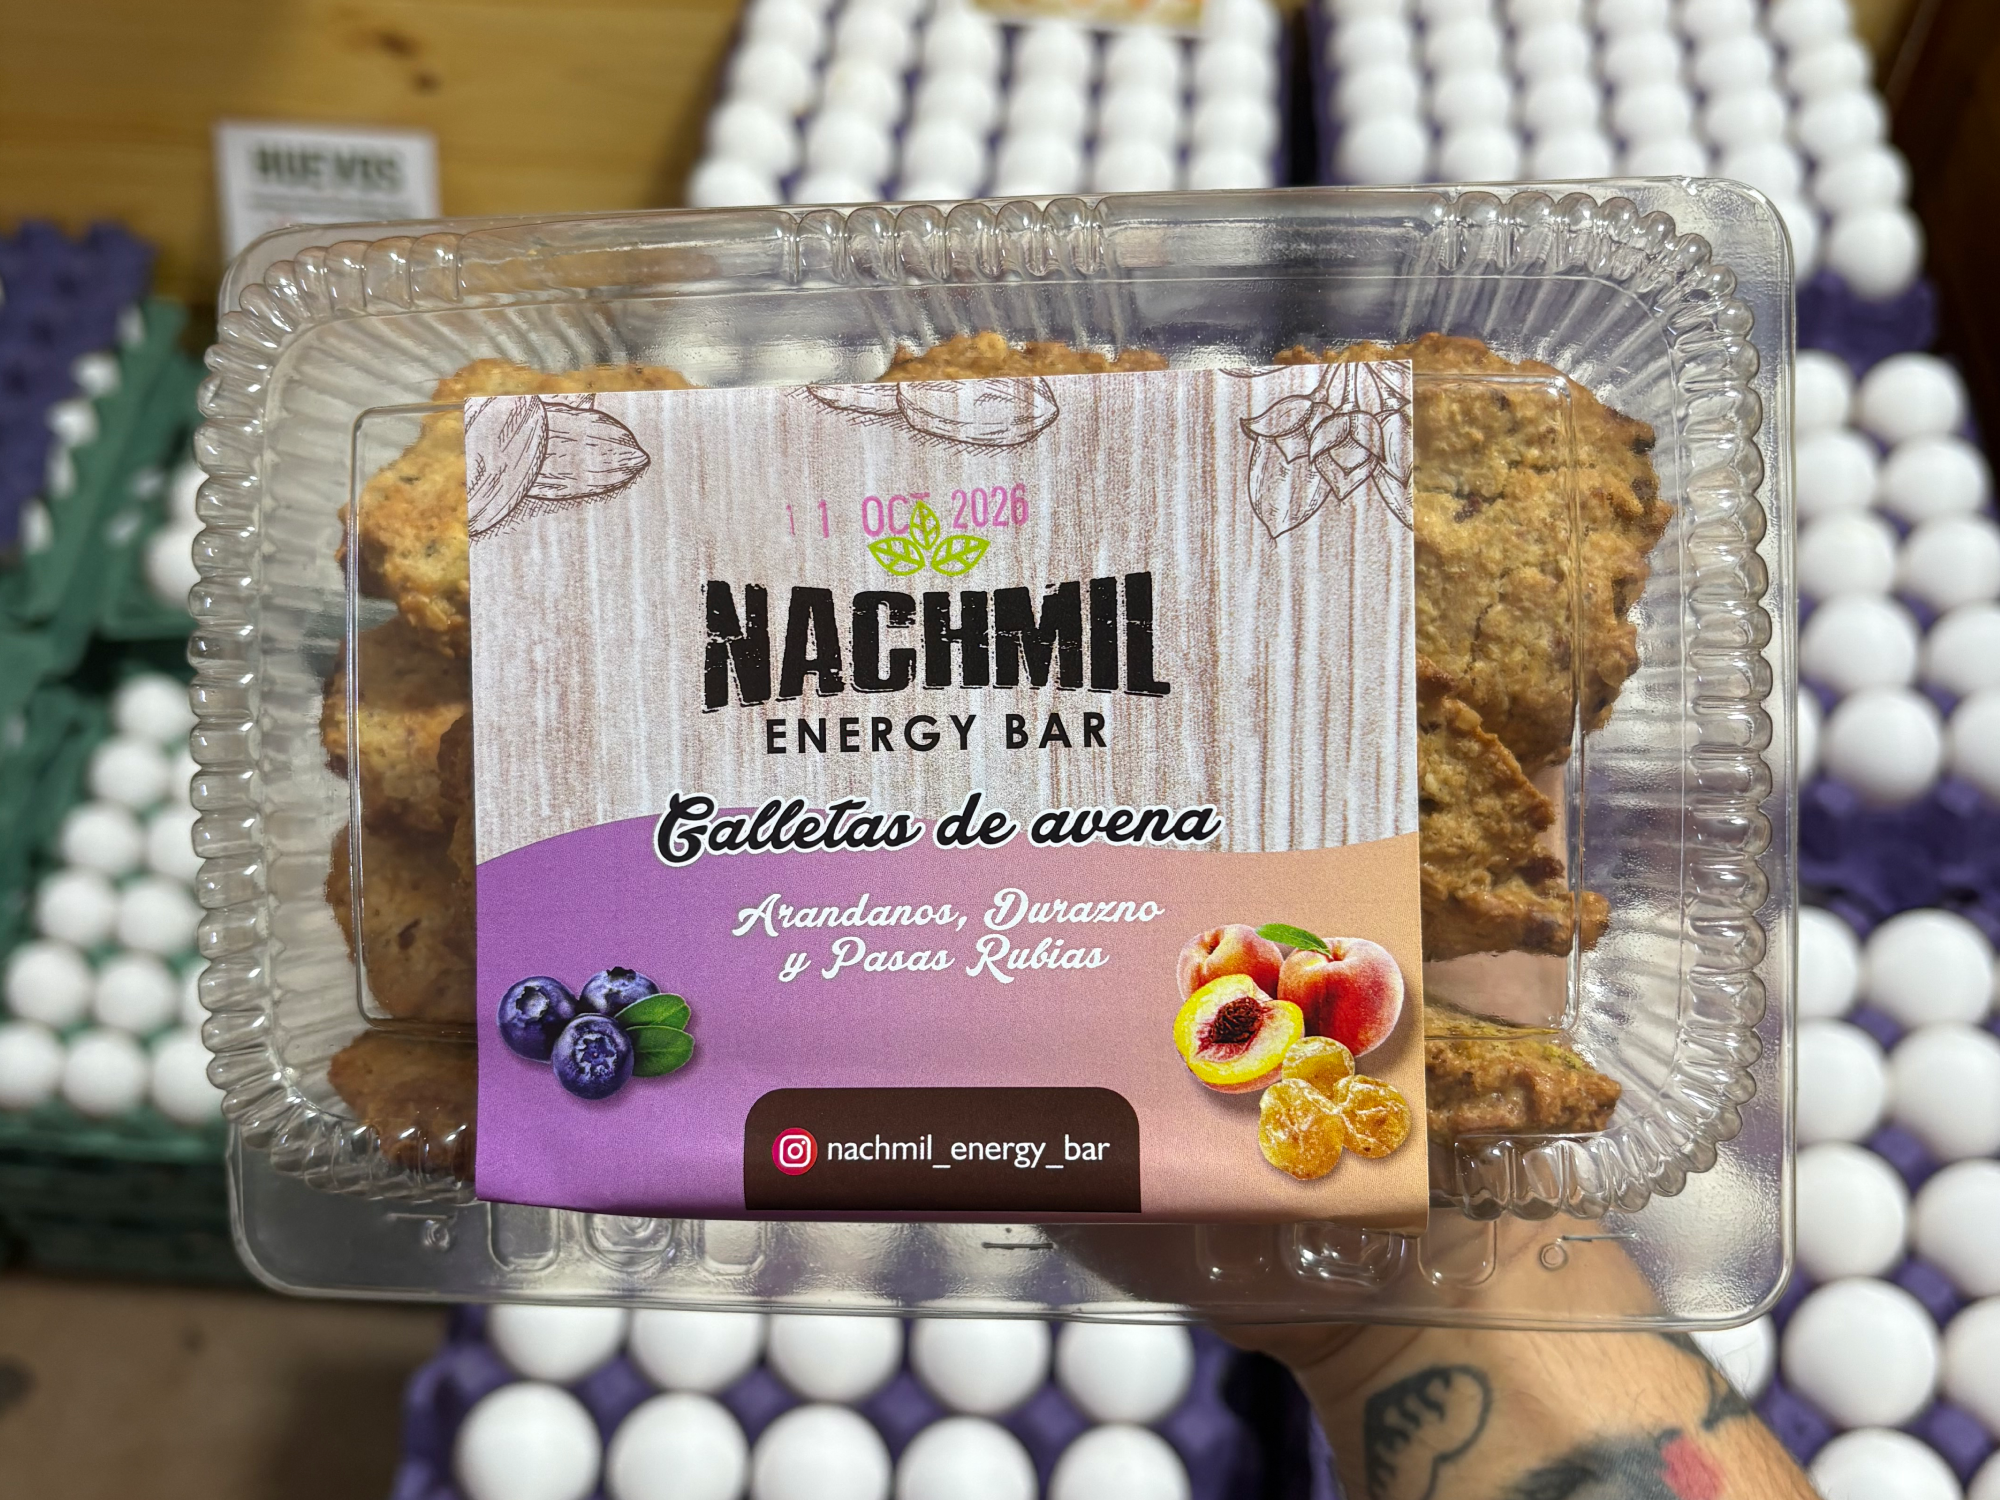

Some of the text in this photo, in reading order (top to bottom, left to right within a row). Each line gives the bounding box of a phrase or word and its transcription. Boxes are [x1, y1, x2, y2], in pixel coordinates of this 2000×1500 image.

[861, 491, 932, 538] OCT
[951, 483, 1030, 530] 2026
[702, 571, 1171, 713] NACHMIL
[766, 711, 1108, 755] ENERGY BAR
[655, 791, 1223, 865] Galletas de avena
[732, 887, 1165, 937] Arandanos, Durazno
[778, 933, 1110, 984] y Pasas Rubias
[826, 1133, 1111, 1169] nachmil_energy_bar
